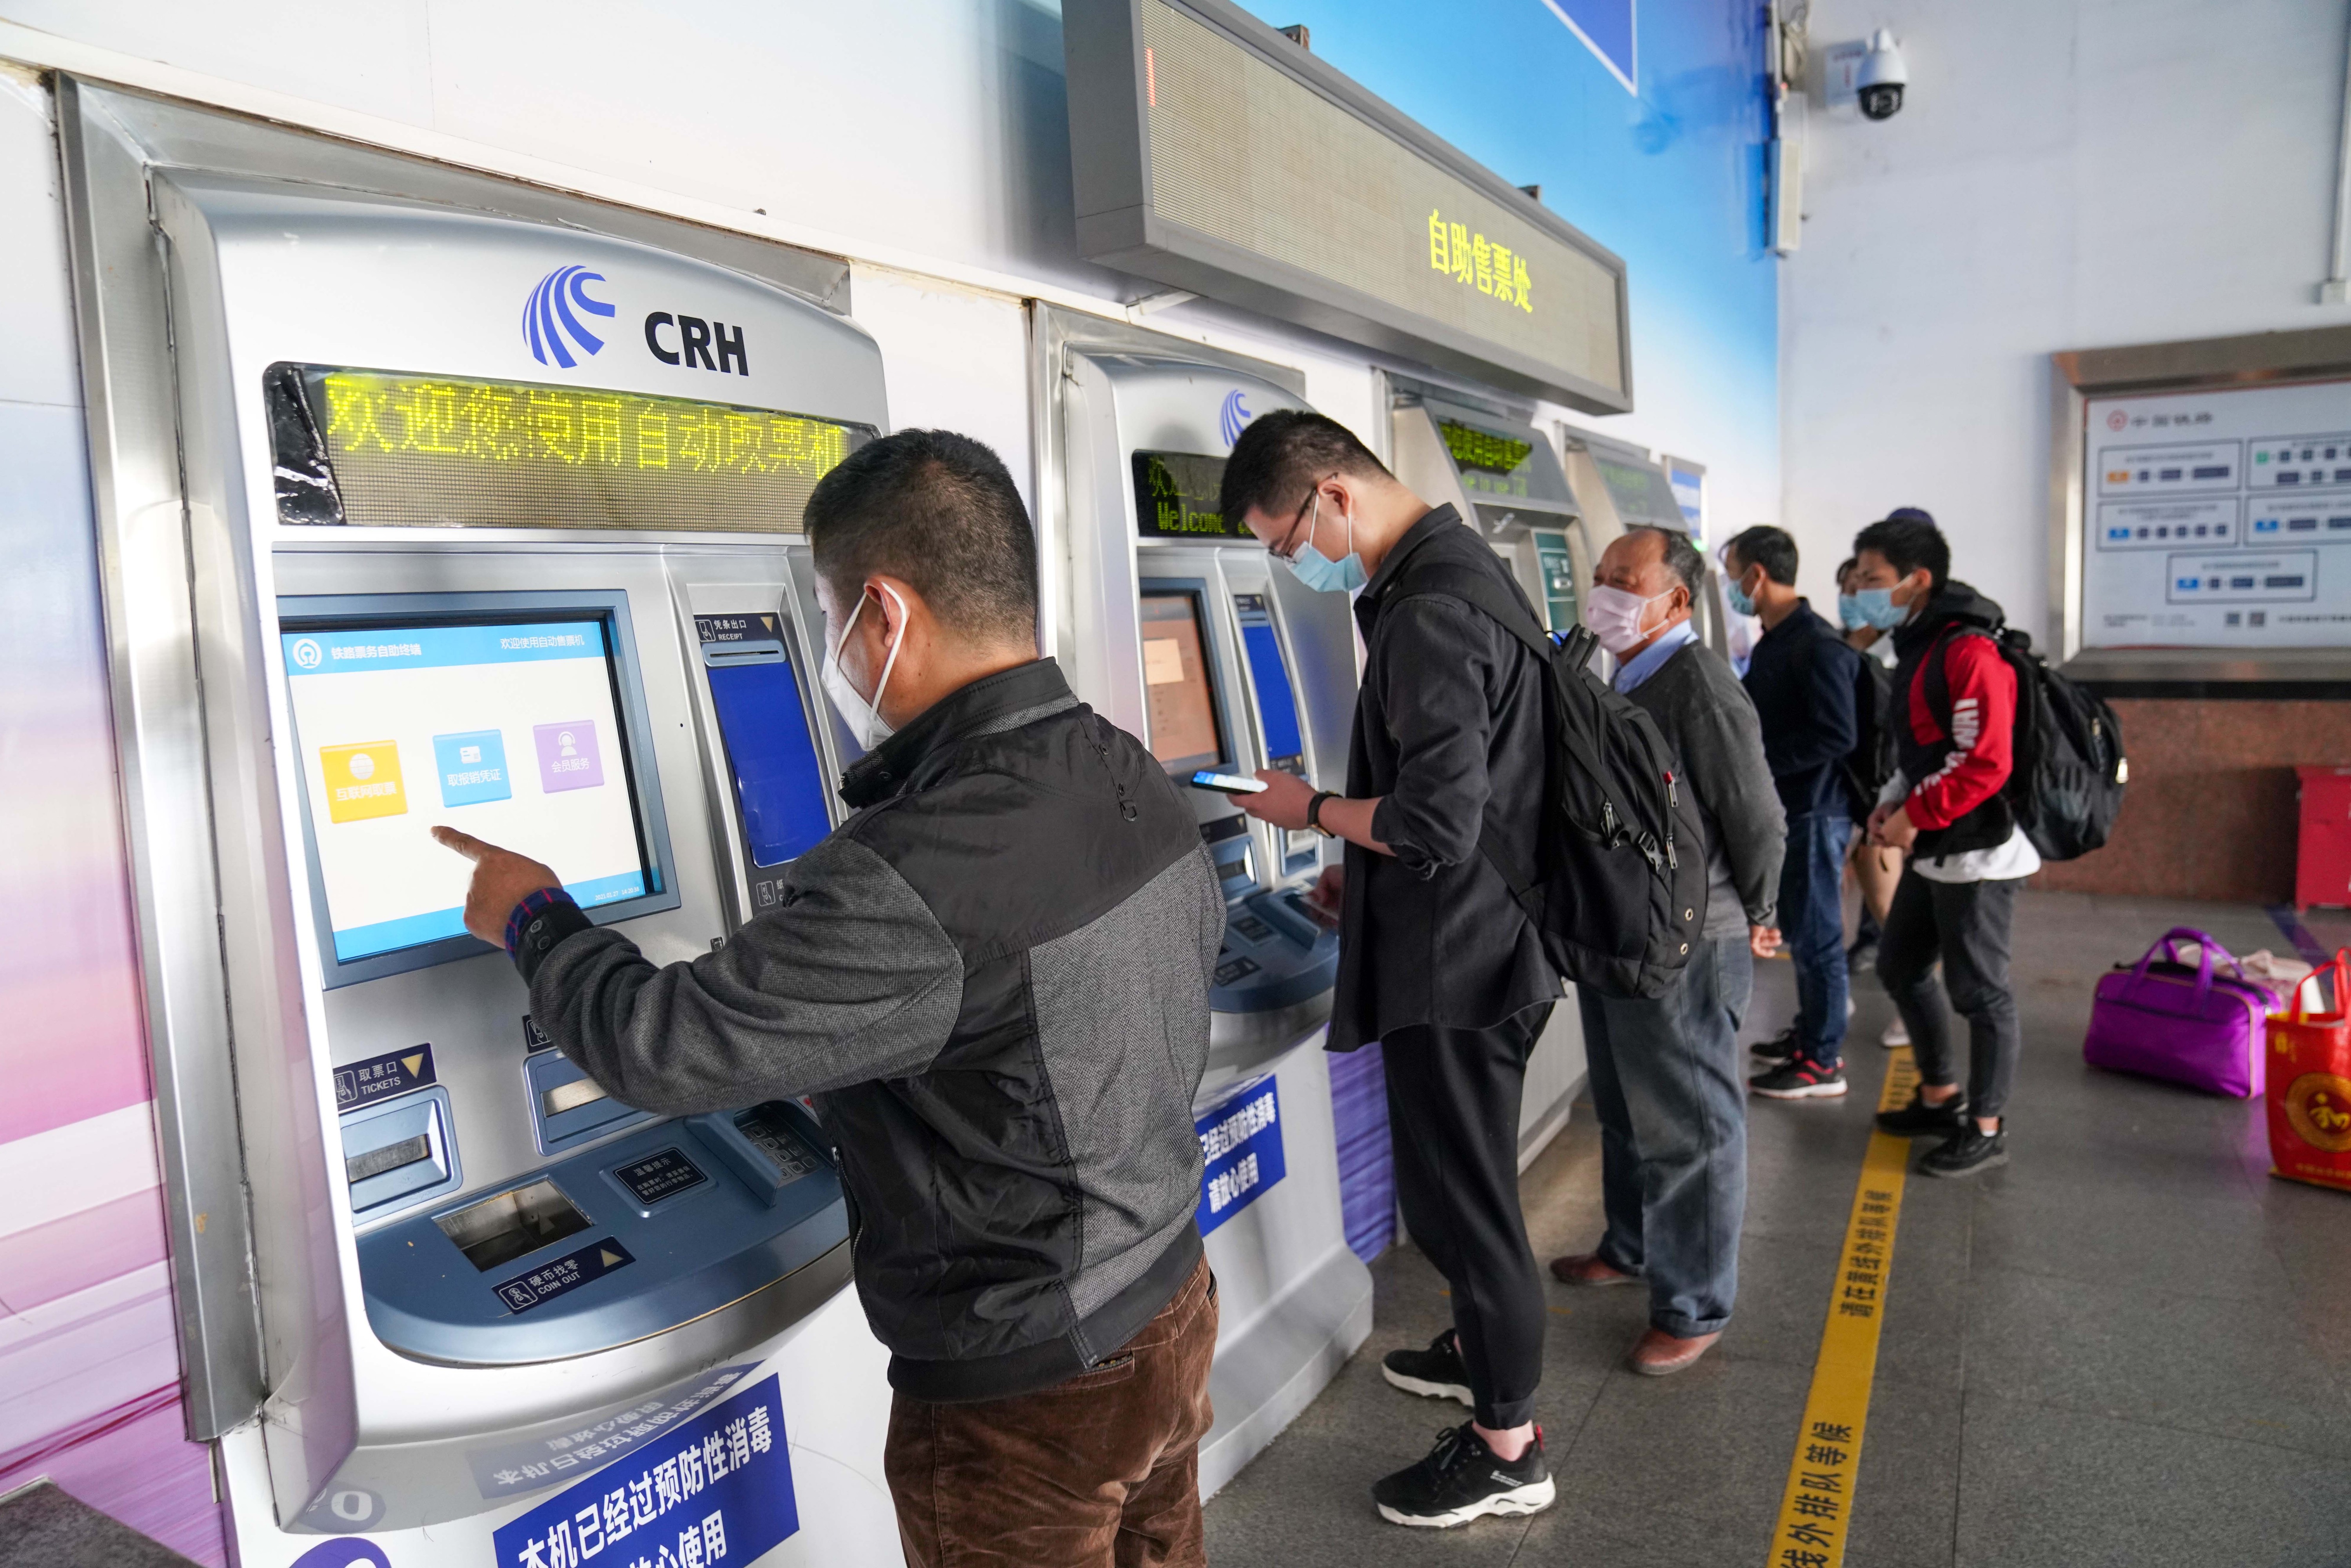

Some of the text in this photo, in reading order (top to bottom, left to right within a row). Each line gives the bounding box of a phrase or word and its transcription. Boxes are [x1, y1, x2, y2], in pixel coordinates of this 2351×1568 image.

[1429, 208, 1533, 313] 自助售票处
[645, 312, 749, 377] CRH
[325, 379, 840, 480] 欢迎您使用自动取票机
[714, 619, 747, 630] 凭条出口
[331, 644, 422, 660] 铁路票务自助终端
[500, 634, 585, 649] 欢迎使用自动售票机
[551, 758, 590, 773] 会员服务
[447, 769, 502, 786] 取报销凭证
[336, 781, 397, 802] 互联网取票
[358, 1061, 398, 1082] 取票口
[360, 1076, 401, 1095] TICKETS
[634, 1158, 672, 1176] 温馨提示
[528, 1259, 579, 1287] 硬币找零
[537, 1272, 581, 1294] COIN OUT
[518, 1405, 771, 1568] 本机已经过预防性消毒
